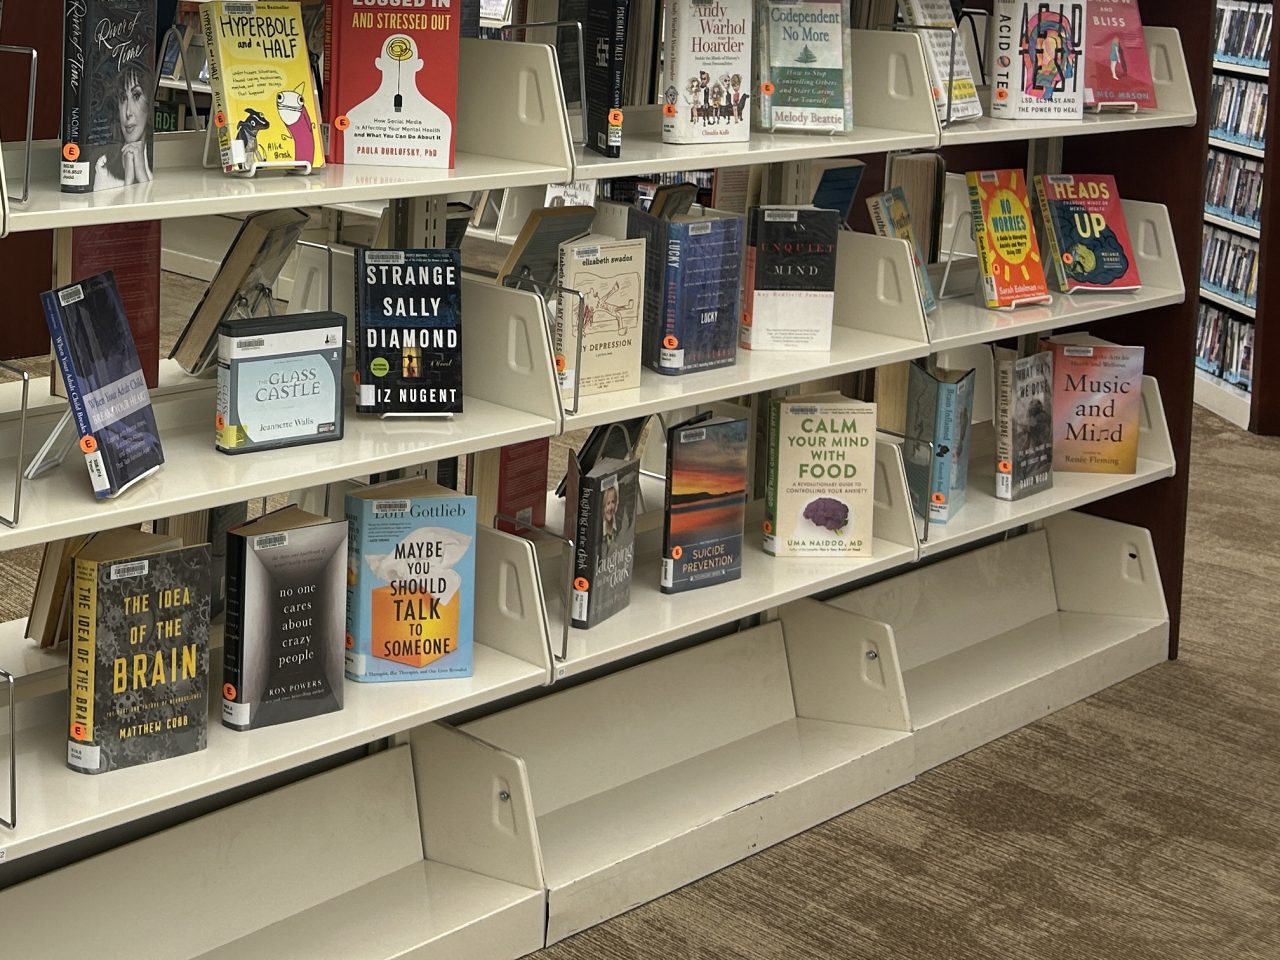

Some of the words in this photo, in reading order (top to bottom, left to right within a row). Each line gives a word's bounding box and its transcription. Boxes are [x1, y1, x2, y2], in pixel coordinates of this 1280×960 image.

[352, 12, 373, 28] AND
[377, 13, 428, 30] STRESSED
[431, 14, 451, 30] OUT
[771, 8, 840, 25] Codependent
[1093, 16, 1126, 27] BLISS
[221, 15, 300, 39] HYPERBOLE
[700, 16, 746, 36] Warhol
[692, 36, 745, 53] Hoarder
[1054, 182, 1110, 199] HEADS
[1000, 200, 1012, 215] NO
[1074, 214, 1106, 238] UP
[582, 255, 609, 267] elizabeth
[610, 254, 633, 264] swados
[366, 265, 456, 286] STRANGE
[774, 264, 819, 276] MIND
[382, 296, 441, 318] SALLY
[367, 328, 458, 349] DIAMOND
[269, 367, 317, 386] GLASS
[1064, 374, 1131, 394] Music
[255, 382, 321, 403] CASTLE
[399, 388, 457, 403] NUGENT
[1076, 399, 1115, 417] and
[801, 418, 857, 434] CALM
[787, 436, 828, 448] YOUR
[831, 435, 870, 447] MIND
[811, 449, 846, 461] WITH
[798, 463, 857, 479] FOOD
[410, 504, 467, 519] Gottlieb
[394, 541, 443, 560] MAYBE
[692, 543, 726, 561] SUICIDE
[787, 539, 806, 547] UMA
[808, 539, 846, 548] NAIDOO,
[849, 539, 863, 547] MD
[407, 560, 431, 575] YOU
[682, 553, 734, 574] PREVENTION
[279, 586, 294, 598] no
[297, 583, 316, 595] one
[390, 579, 447, 595] SHOULD
[123, 593, 150, 614] THE
[158, 586, 191, 608] IDEA
[393, 597, 441, 622] TALK
[130, 626, 147, 645] OF
[156, 617, 182, 637] THE
[408, 622, 423, 636] TO
[384, 638, 451, 657] SOMEONE
[113, 643, 198, 695] BRAIN
[269, 686, 286, 696] RON
[289, 679, 322, 694] POWERS
